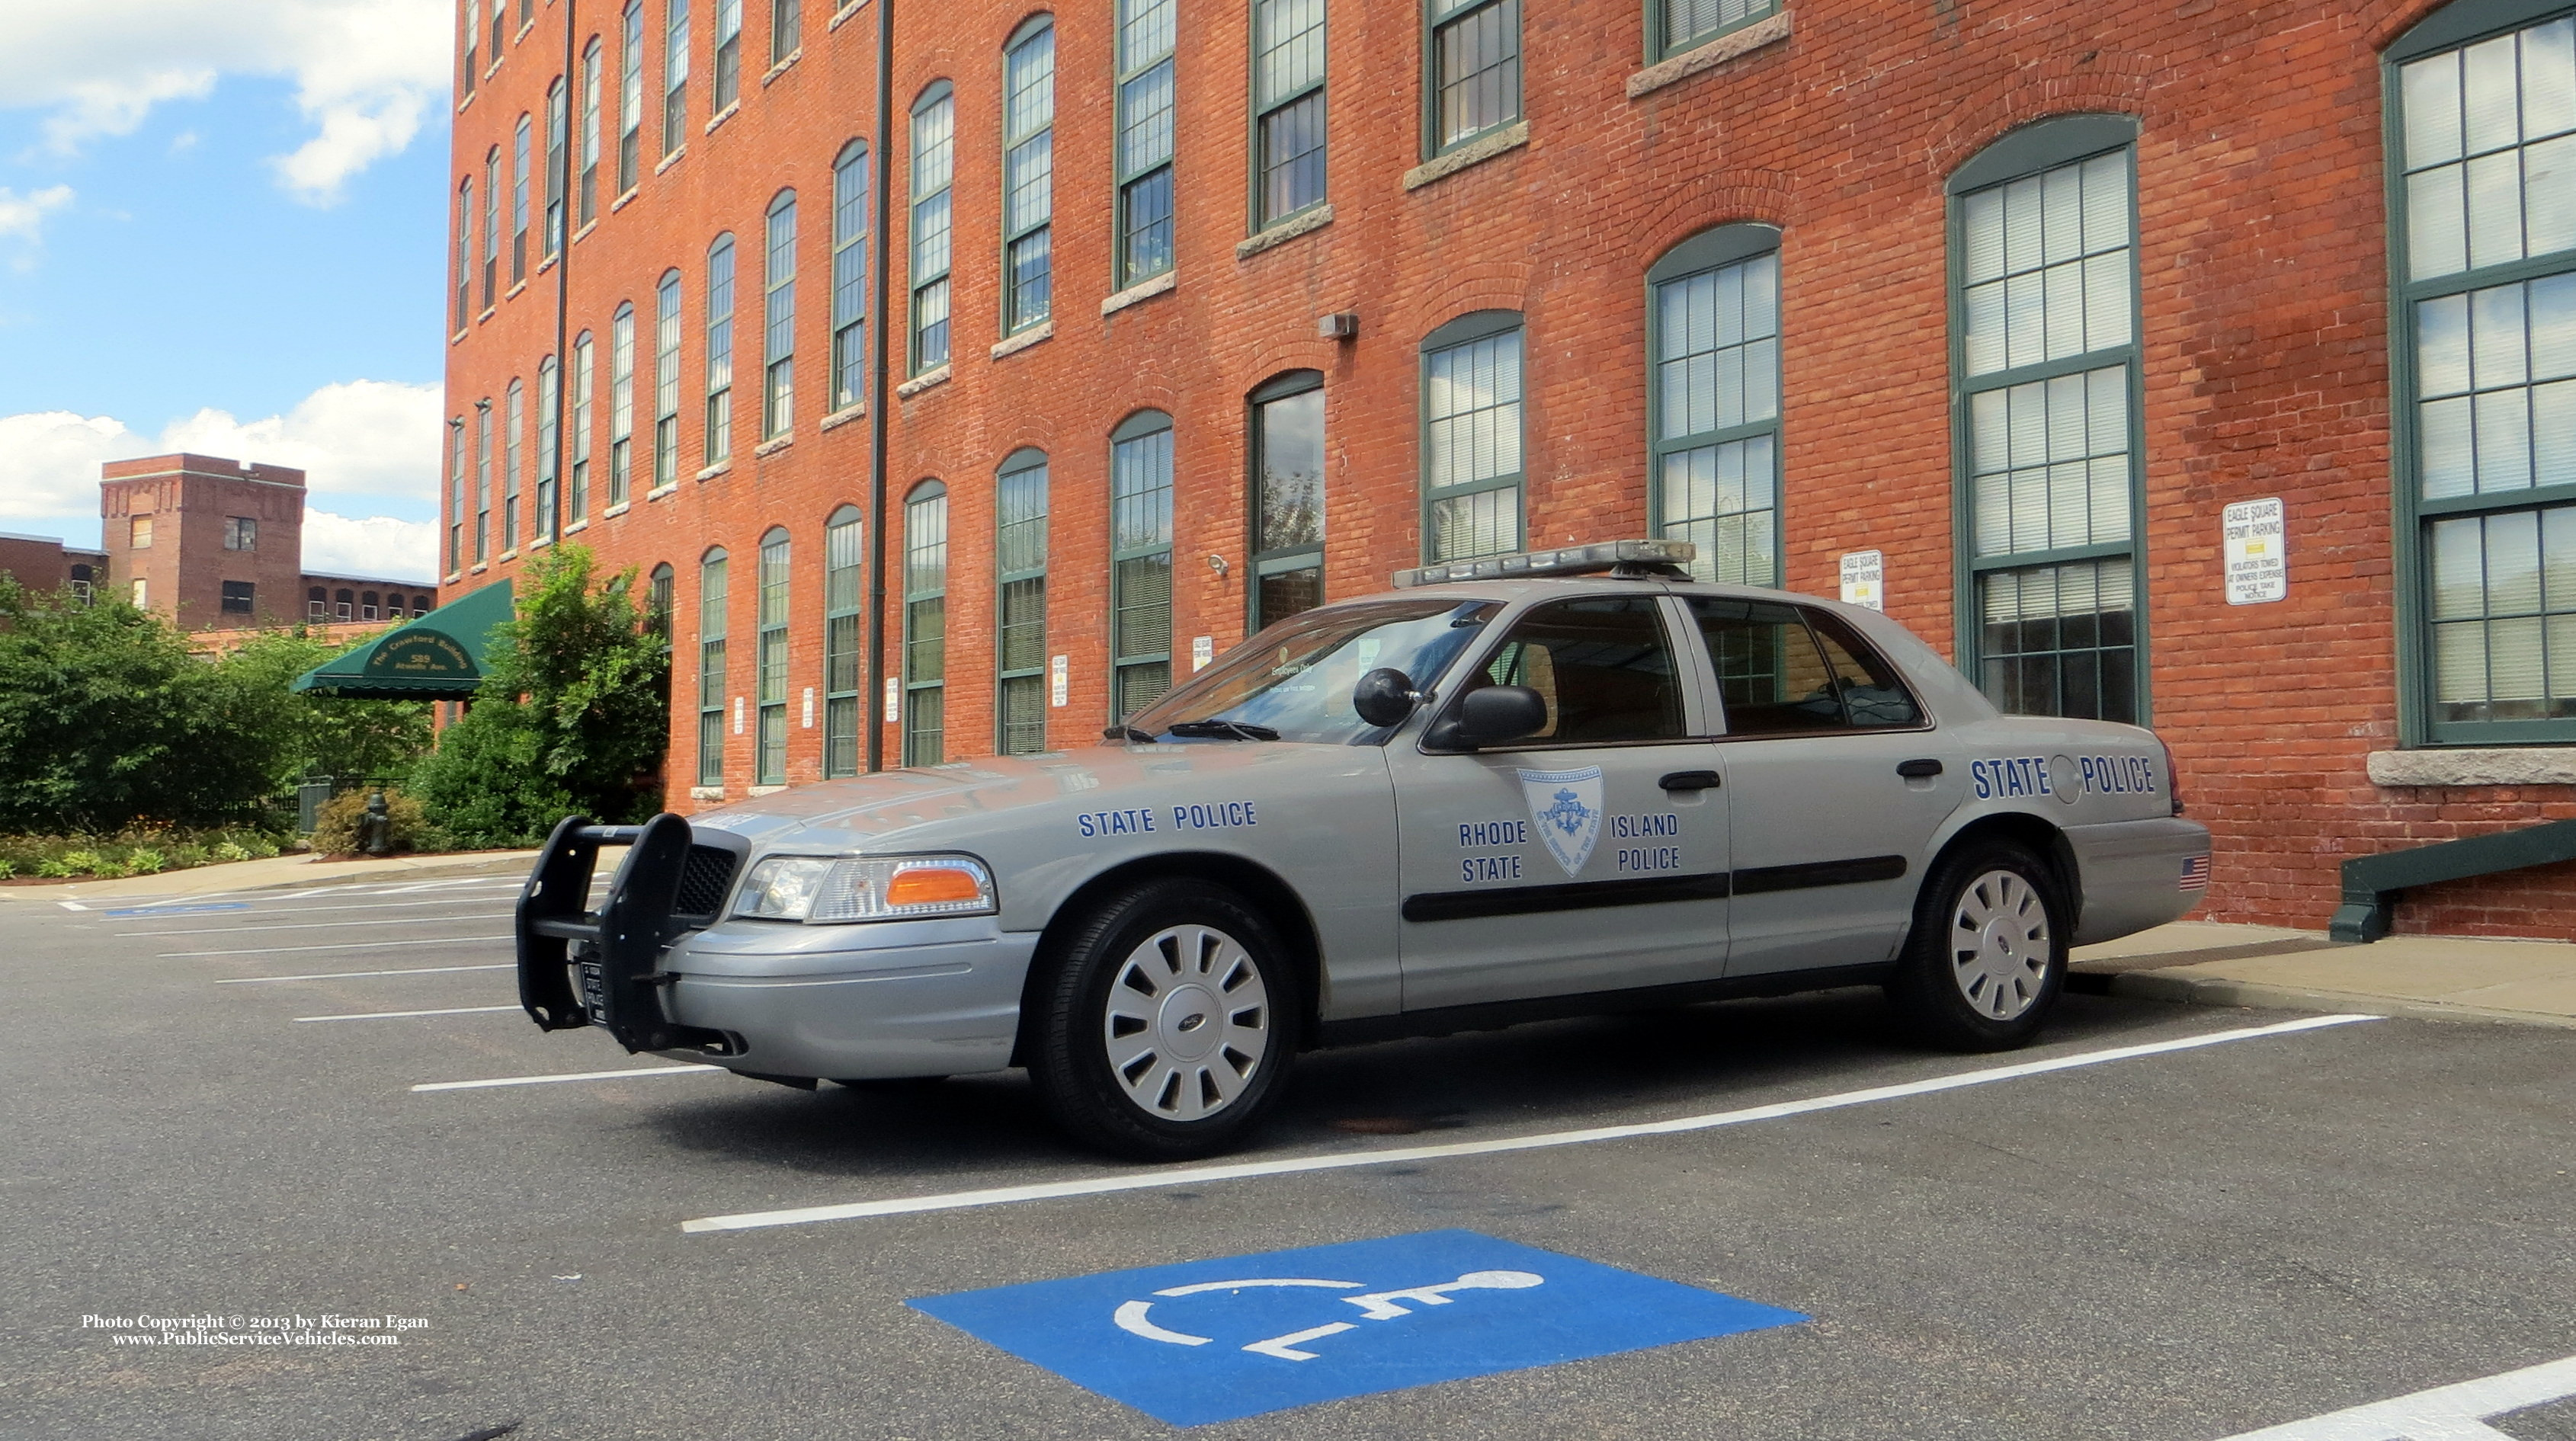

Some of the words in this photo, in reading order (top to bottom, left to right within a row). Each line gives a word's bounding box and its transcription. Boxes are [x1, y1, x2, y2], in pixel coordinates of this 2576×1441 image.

[2227, 507, 2248, 522] EAGLE
[2251, 502, 2278, 519] SQUARE
[2226, 525, 2250, 540] PERMIT
[2252, 520, 2280, 537] PARKING
[1843, 556, 1858, 569] EAGLE
[1860, 554, 1879, 568] SQUARE
[2231, 560, 2259, 572] VIOLATORS
[2260, 558, 2279, 568] TOWED
[1843, 572, 1859, 584] PERMIT
[1860, 570, 1880, 582] PARKING
[2228, 574, 2234, 583] AT
[2259, 568, 2283, 579] EXPENSE
[2235, 583, 2257, 592] POLICE
[2260, 581, 2276, 589] TAKE
[2244, 591, 2267, 599] NOTICE
[372, 652, 389, 665] The
[389, 636, 435, 651] Crawford
[437, 639, 468, 670] Building
[410, 654, 431, 663] 589
[1970, 755, 2052, 800] STATE
[2078, 755, 2156, 795] POLICE
[1077, 807, 1156, 838] STATE
[1172, 800, 1258, 831] POLICE
[1458, 820, 1528, 848] RHODE
[1610, 813, 1679, 839] ISLAND
[1462, 855, 1522, 882] STATE
[1618, 847, 1680, 873] POLICE
